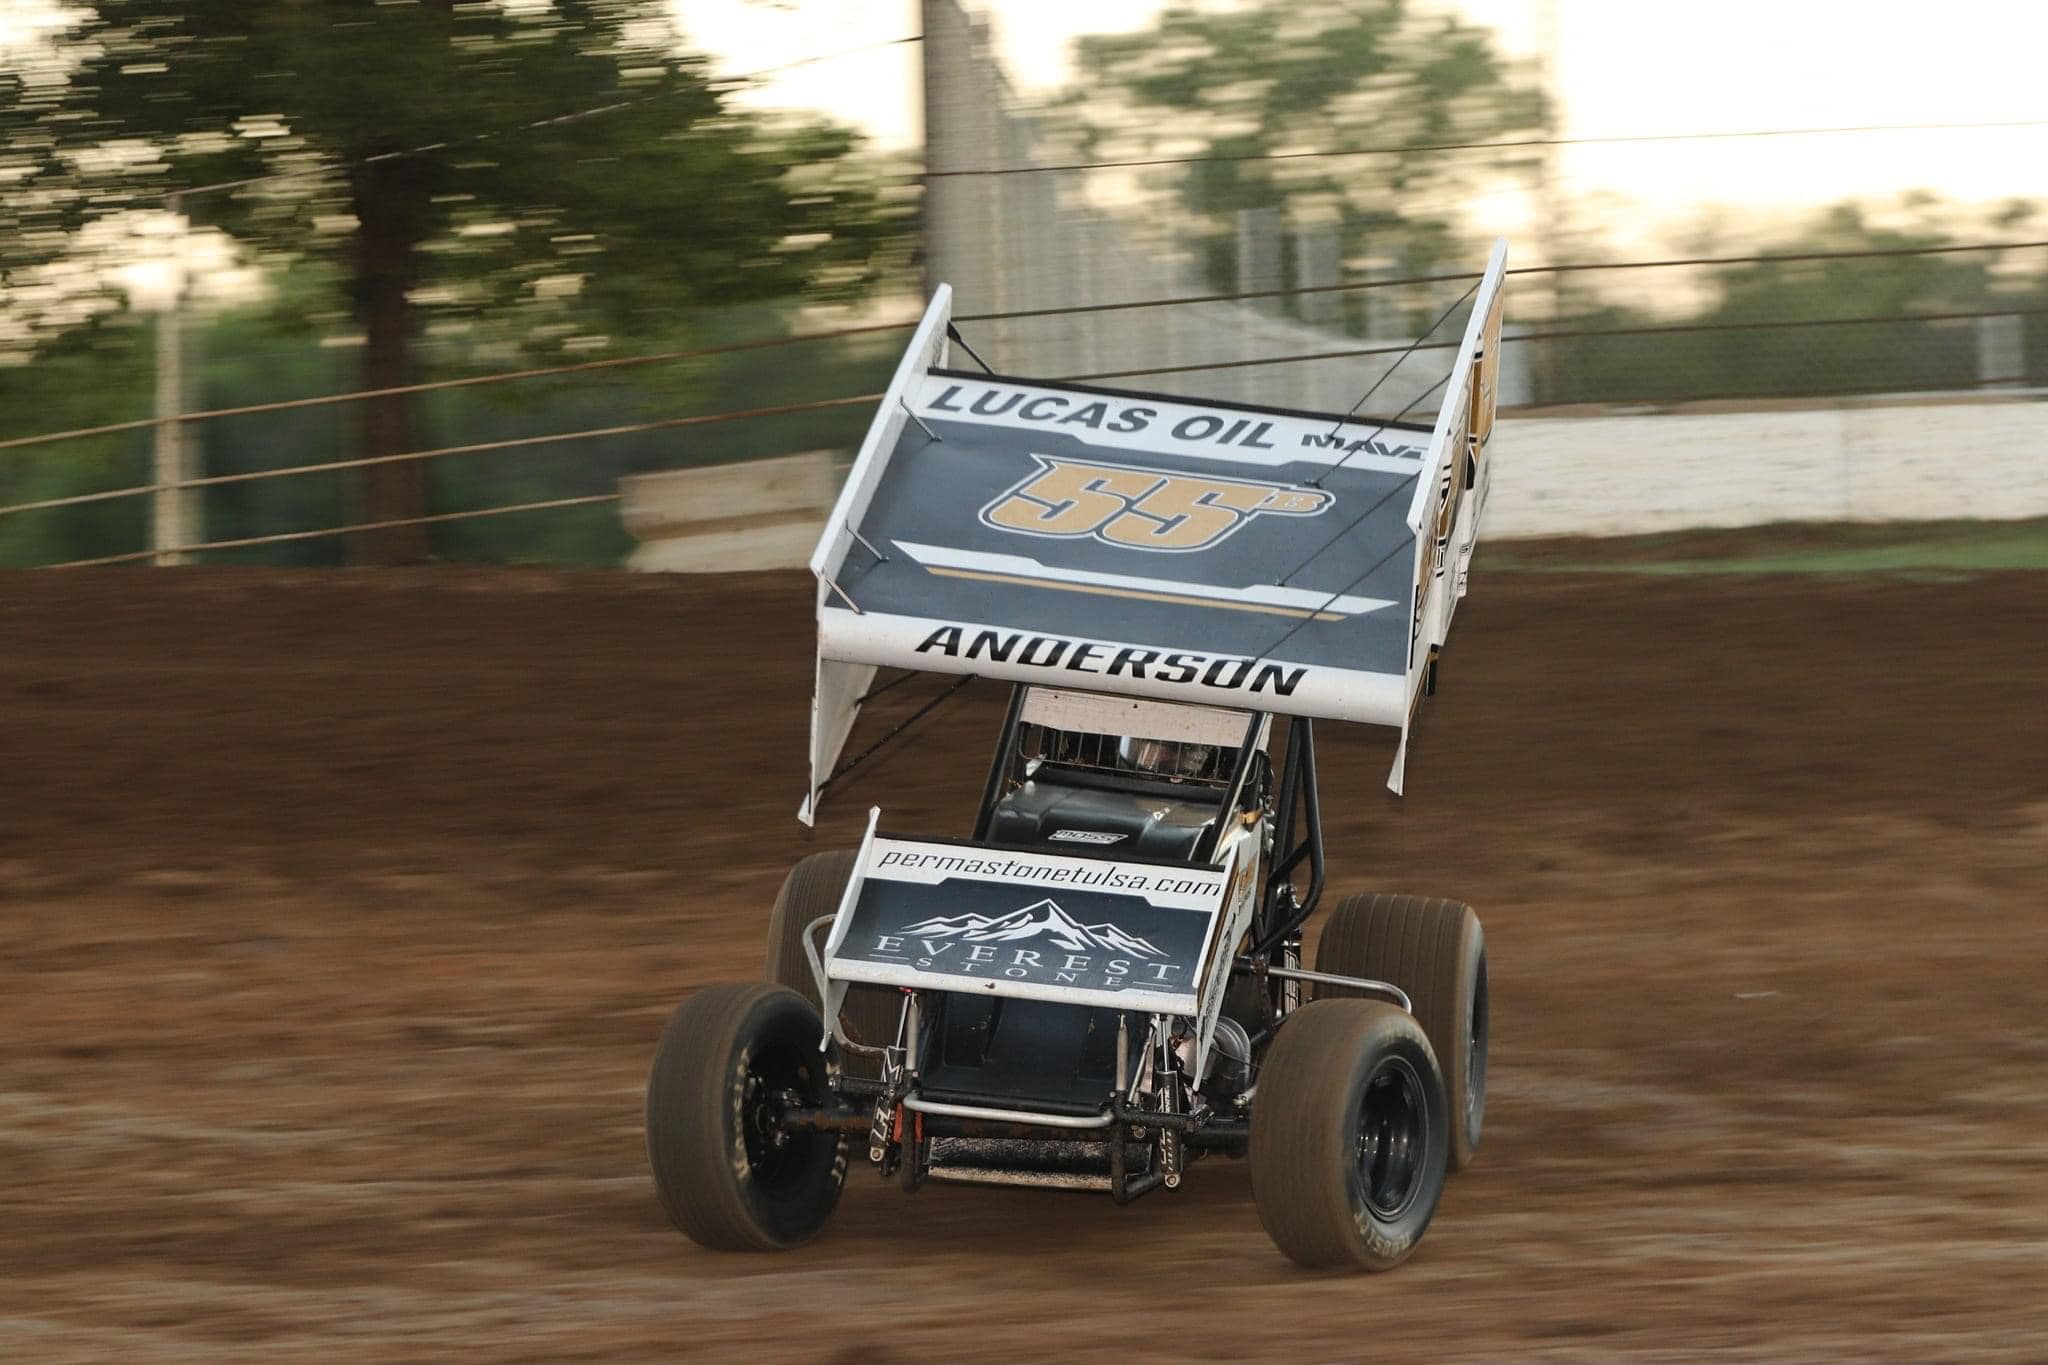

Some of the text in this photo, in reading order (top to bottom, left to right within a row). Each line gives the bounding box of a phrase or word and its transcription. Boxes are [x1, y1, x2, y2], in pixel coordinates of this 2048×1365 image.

[926, 386, 1157, 433] LUCAS
[1170, 417, 1276, 449] OIL
[915, 627, 1308, 697] ANDERSON
[877, 849, 1221, 897] permastonetulsa.com
[873, 935, 1180, 980] EVEREST
[916, 957, 1123, 986] STONE
